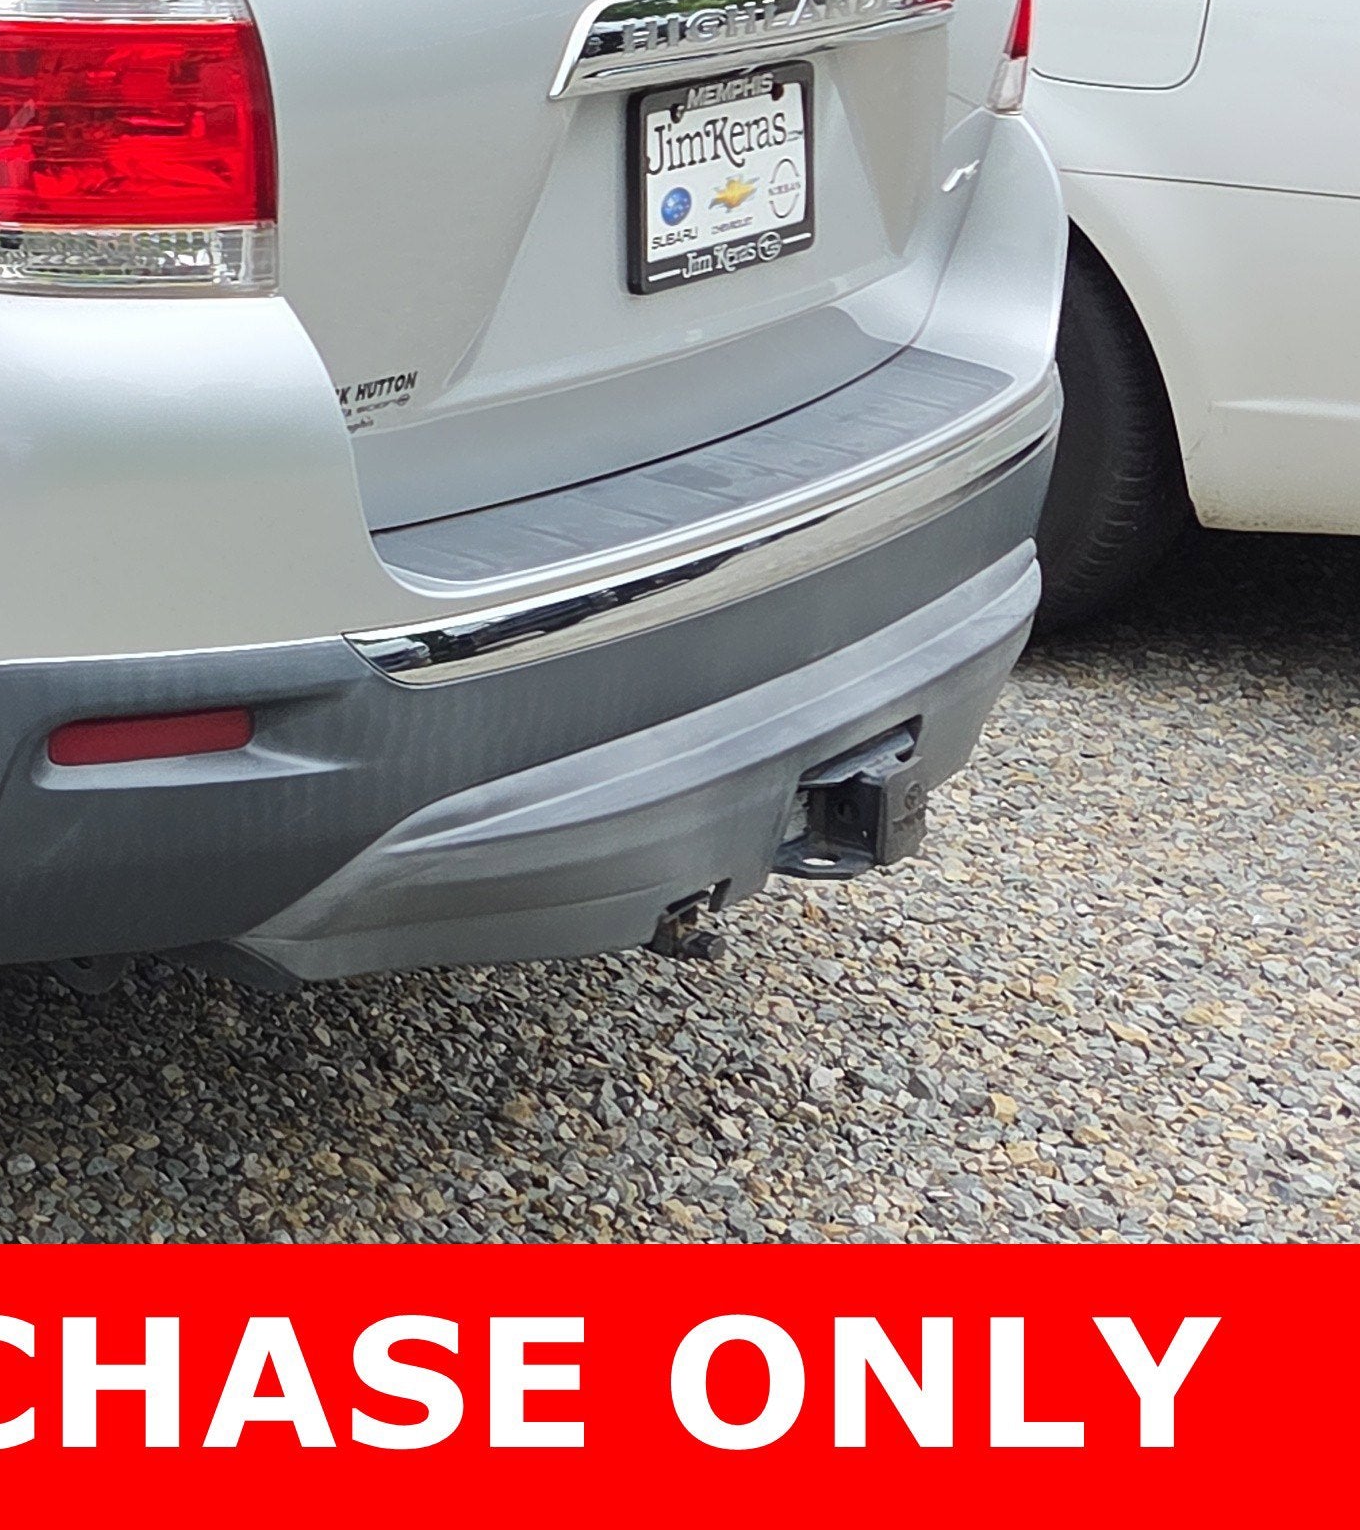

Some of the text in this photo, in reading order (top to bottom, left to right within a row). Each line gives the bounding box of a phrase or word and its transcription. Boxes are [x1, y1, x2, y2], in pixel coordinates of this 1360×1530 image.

[686, 72, 774, 110] MEMPHIS
[682, 242, 757, 279] Jim Keras
[355, 370, 419, 401] HUTTON
